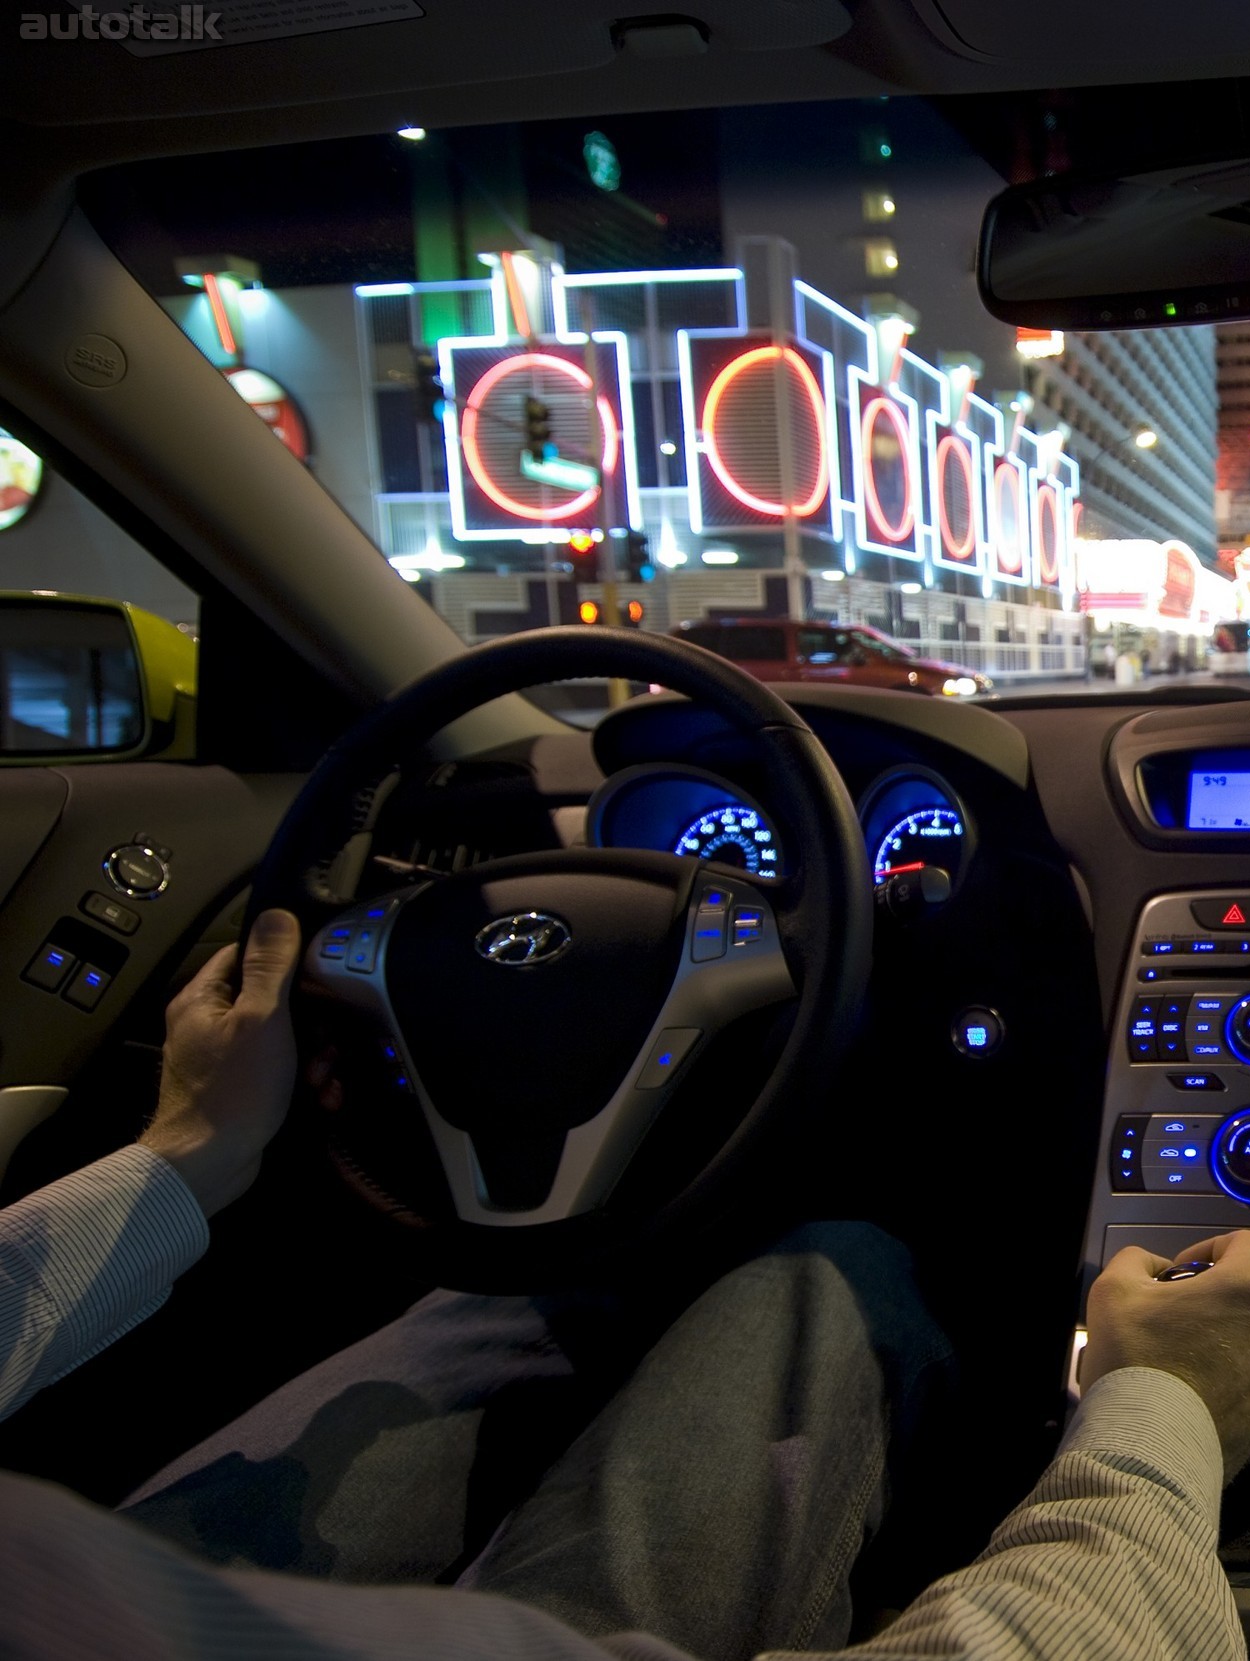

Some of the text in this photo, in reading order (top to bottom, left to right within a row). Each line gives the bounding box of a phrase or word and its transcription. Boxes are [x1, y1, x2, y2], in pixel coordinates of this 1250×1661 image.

[741, 817, 758, 829] 100
[931, 816, 941, 828] 4
[700, 822, 715, 835] 60
[908, 822, 918, 835] 3
[754, 830, 772, 842] 120
[892, 837, 902, 851] 2
[1132, 1028, 1154, 1036] TRACK
[1162, 1024, 1178, 1032] DISC
[1185, 1078, 1205, 1086] SCAN
[1168, 1175, 1182, 1183] OFF
